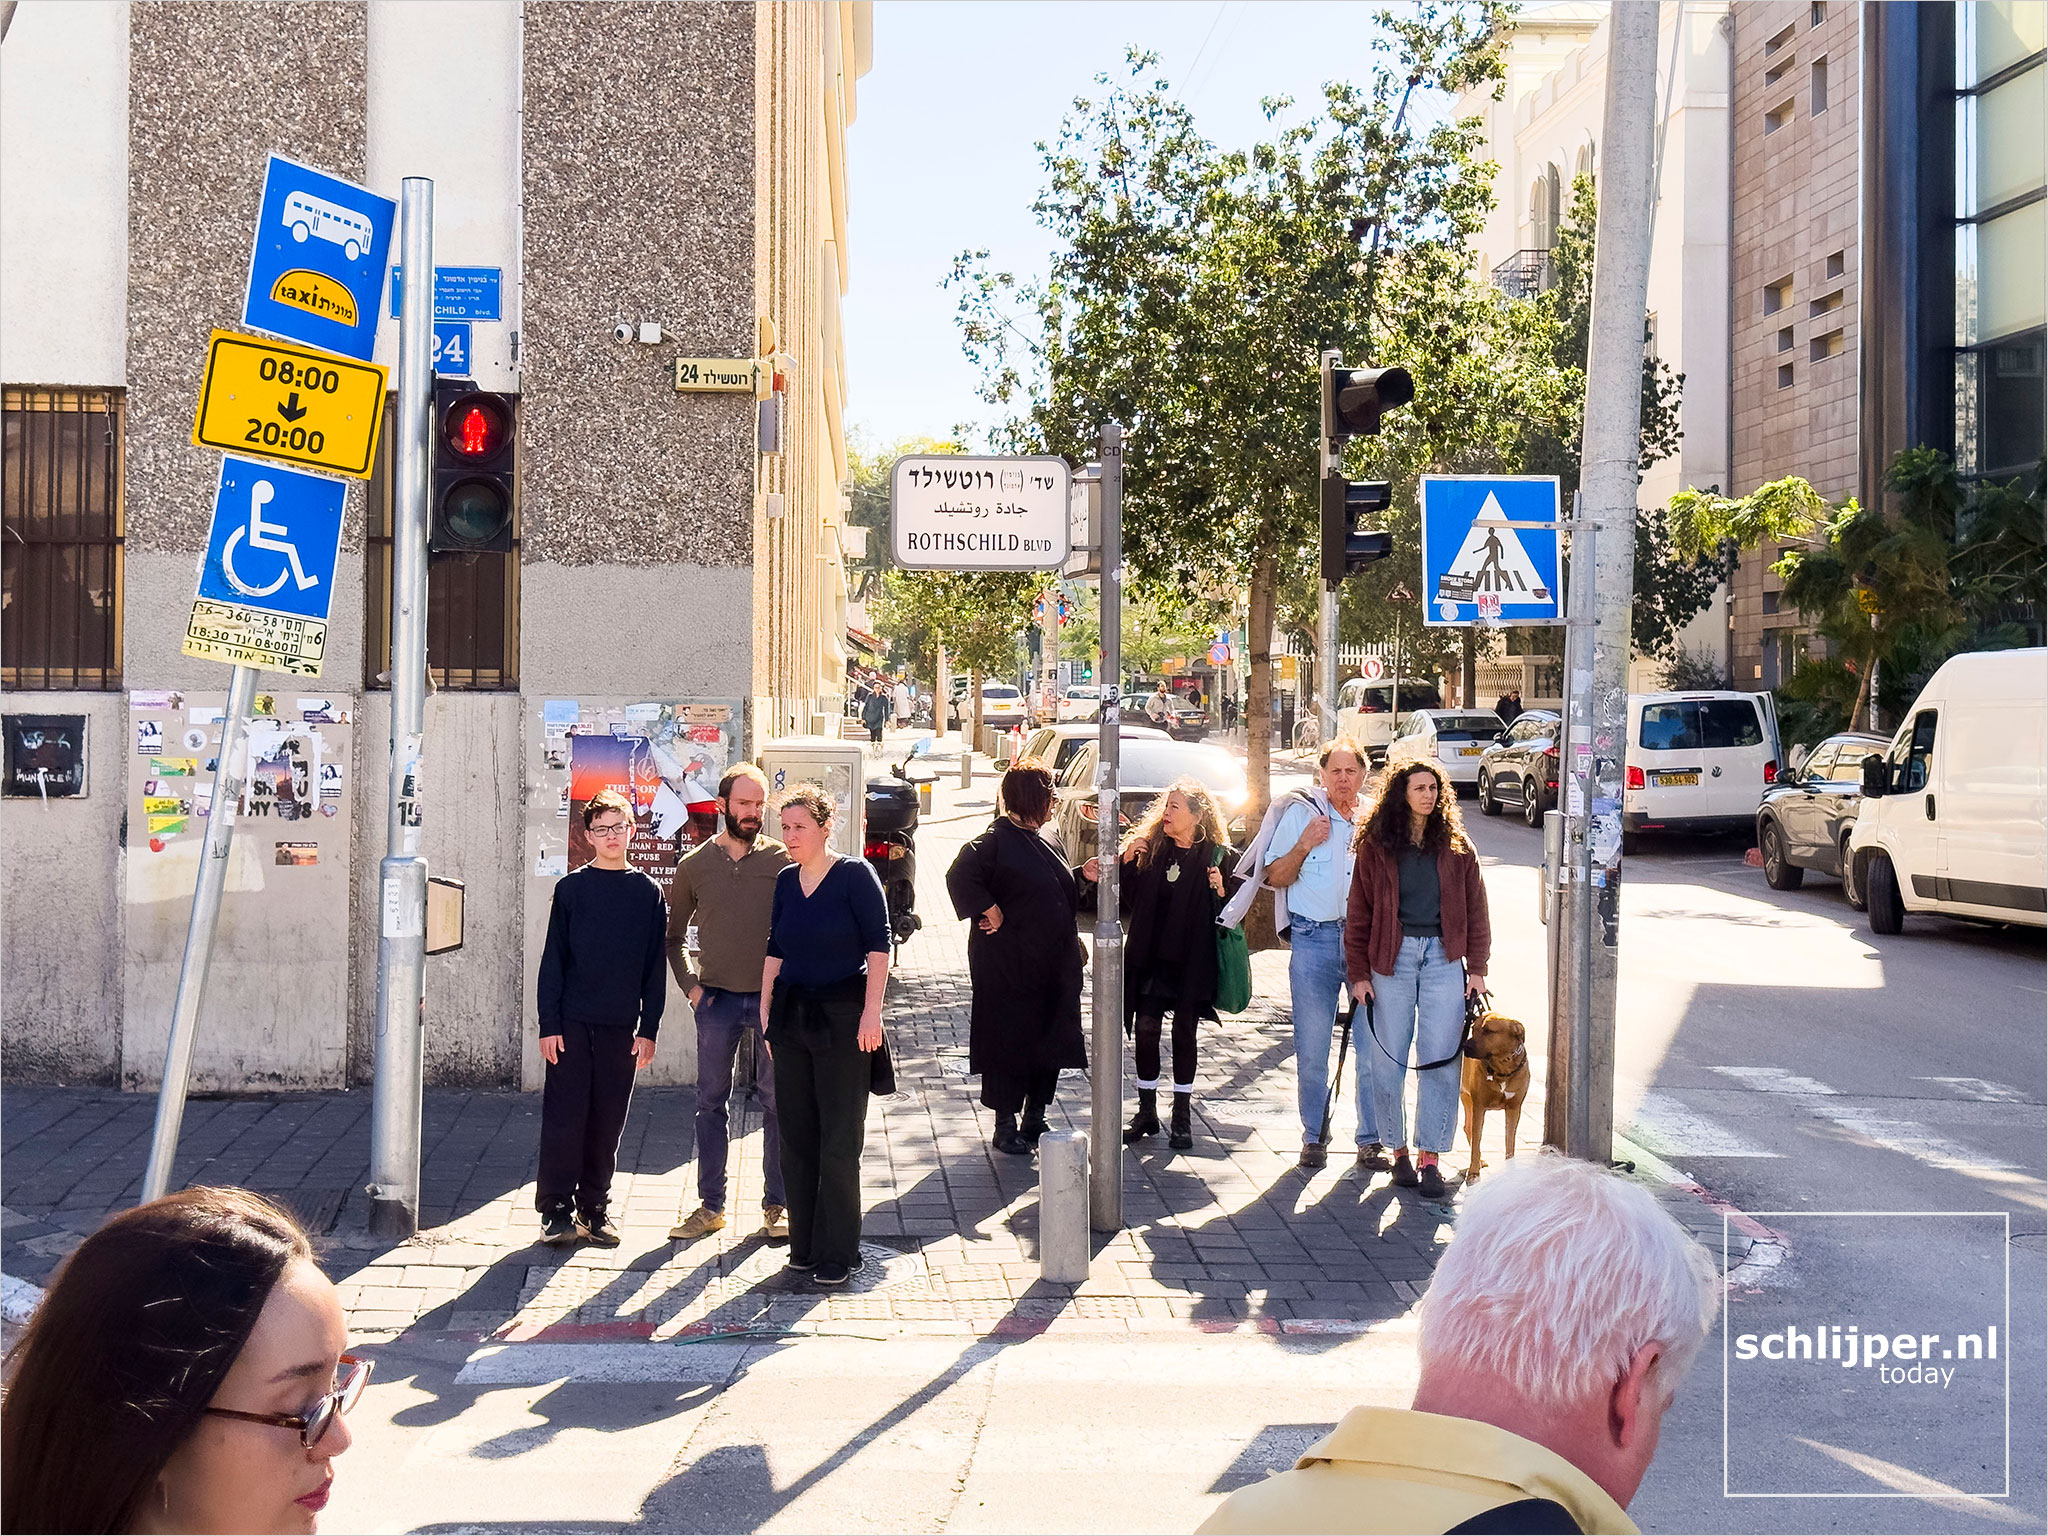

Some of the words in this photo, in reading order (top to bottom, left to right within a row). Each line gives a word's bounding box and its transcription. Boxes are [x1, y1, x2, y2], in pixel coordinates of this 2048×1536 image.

[281, 284, 318, 307] taxi
[318, 296, 353, 320] מונית
[434, 305, 466, 315] CHILD
[259, 357, 339, 394] 08:00
[680, 363, 699, 384] 24
[703, 369, 748, 385] רוטשילד
[244, 418, 325, 454] 20:00
[1103, 446, 1121, 457] CD
[908, 465, 994, 490] רוטשילד
[933, 501, 989, 519] روتشيلد
[996, 502, 1029, 518] جادة
[907, 532, 1019, 552] ROTHSCHILD
[1023, 539, 1052, 552] BLVD
[191, 626, 230, 641] 18:30
[313, 631, 324, 645] 6
[184, 639, 219, 653] יגרר
[225, 647, 256, 661] אחר
[604, 783, 631, 795] THE
[656, 843, 674, 851] RED
